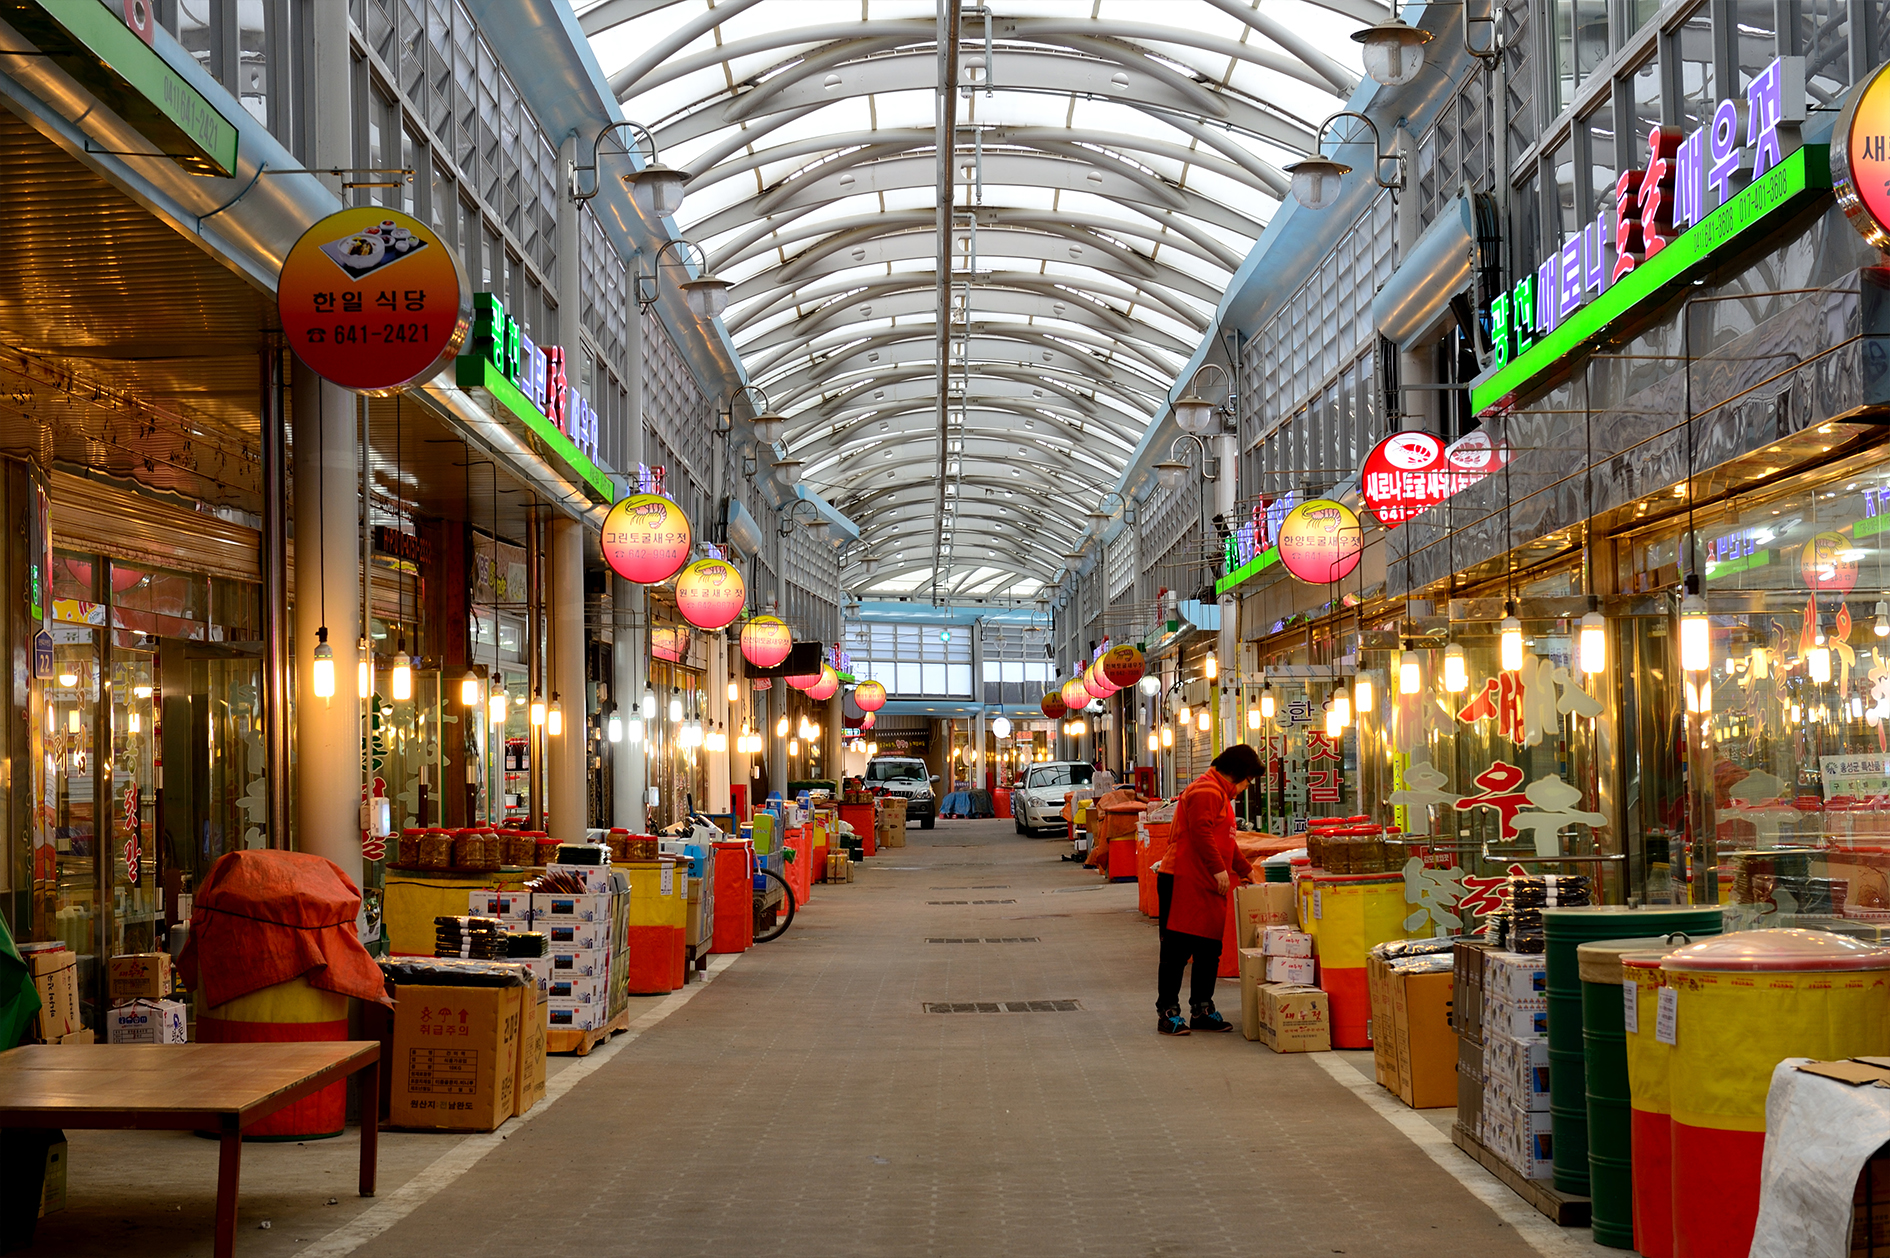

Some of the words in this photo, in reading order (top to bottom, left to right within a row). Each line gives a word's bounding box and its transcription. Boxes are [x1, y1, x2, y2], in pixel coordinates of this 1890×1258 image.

[1862, 136, 1890, 161] 새
[1738, 168, 1788, 223] 017-401-3608
[312, 291, 363, 313] 한일
[375, 290, 426, 312] 식당
[334, 323, 429, 344] 641-2421
[606, 532, 687, 544] 그린토굴새우젓
[628, 549, 677, 559] 642-9944
[40, 654, 50, 673] 22
[1840, 762, 1860, 773] 홍성군
[1861, 761, 1881, 772] 특산품
[420, 1024, 470, 1036] 취급주의
